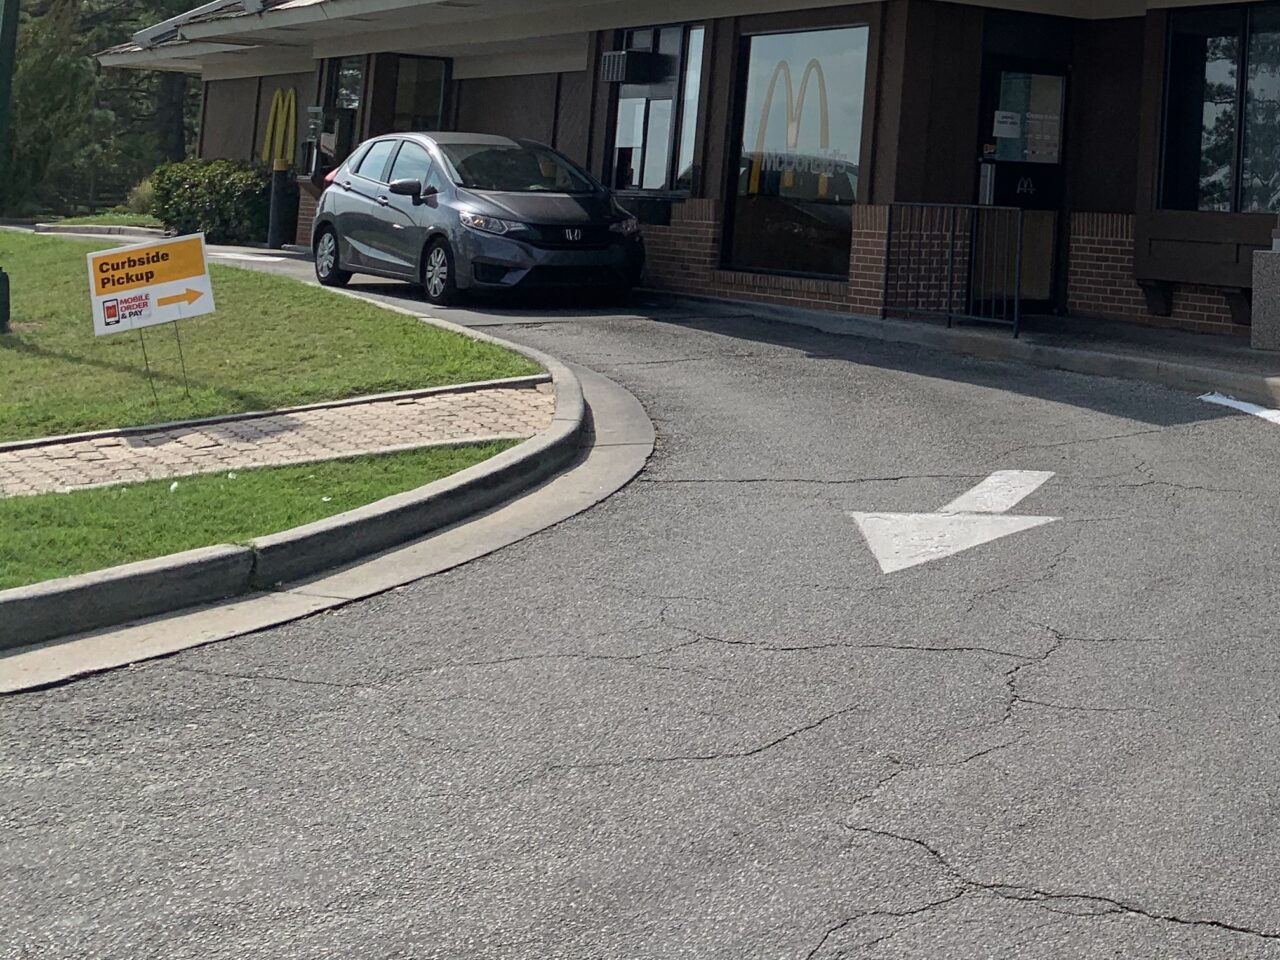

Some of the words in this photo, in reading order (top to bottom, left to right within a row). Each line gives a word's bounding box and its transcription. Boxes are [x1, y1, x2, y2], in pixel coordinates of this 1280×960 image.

[99, 251, 169, 273] Curbside
[101, 270, 155, 289] Pickup
[120, 293, 150, 305] MOBILE
[120, 301, 149, 313] ORDER
[129, 309, 143, 318] PAY
